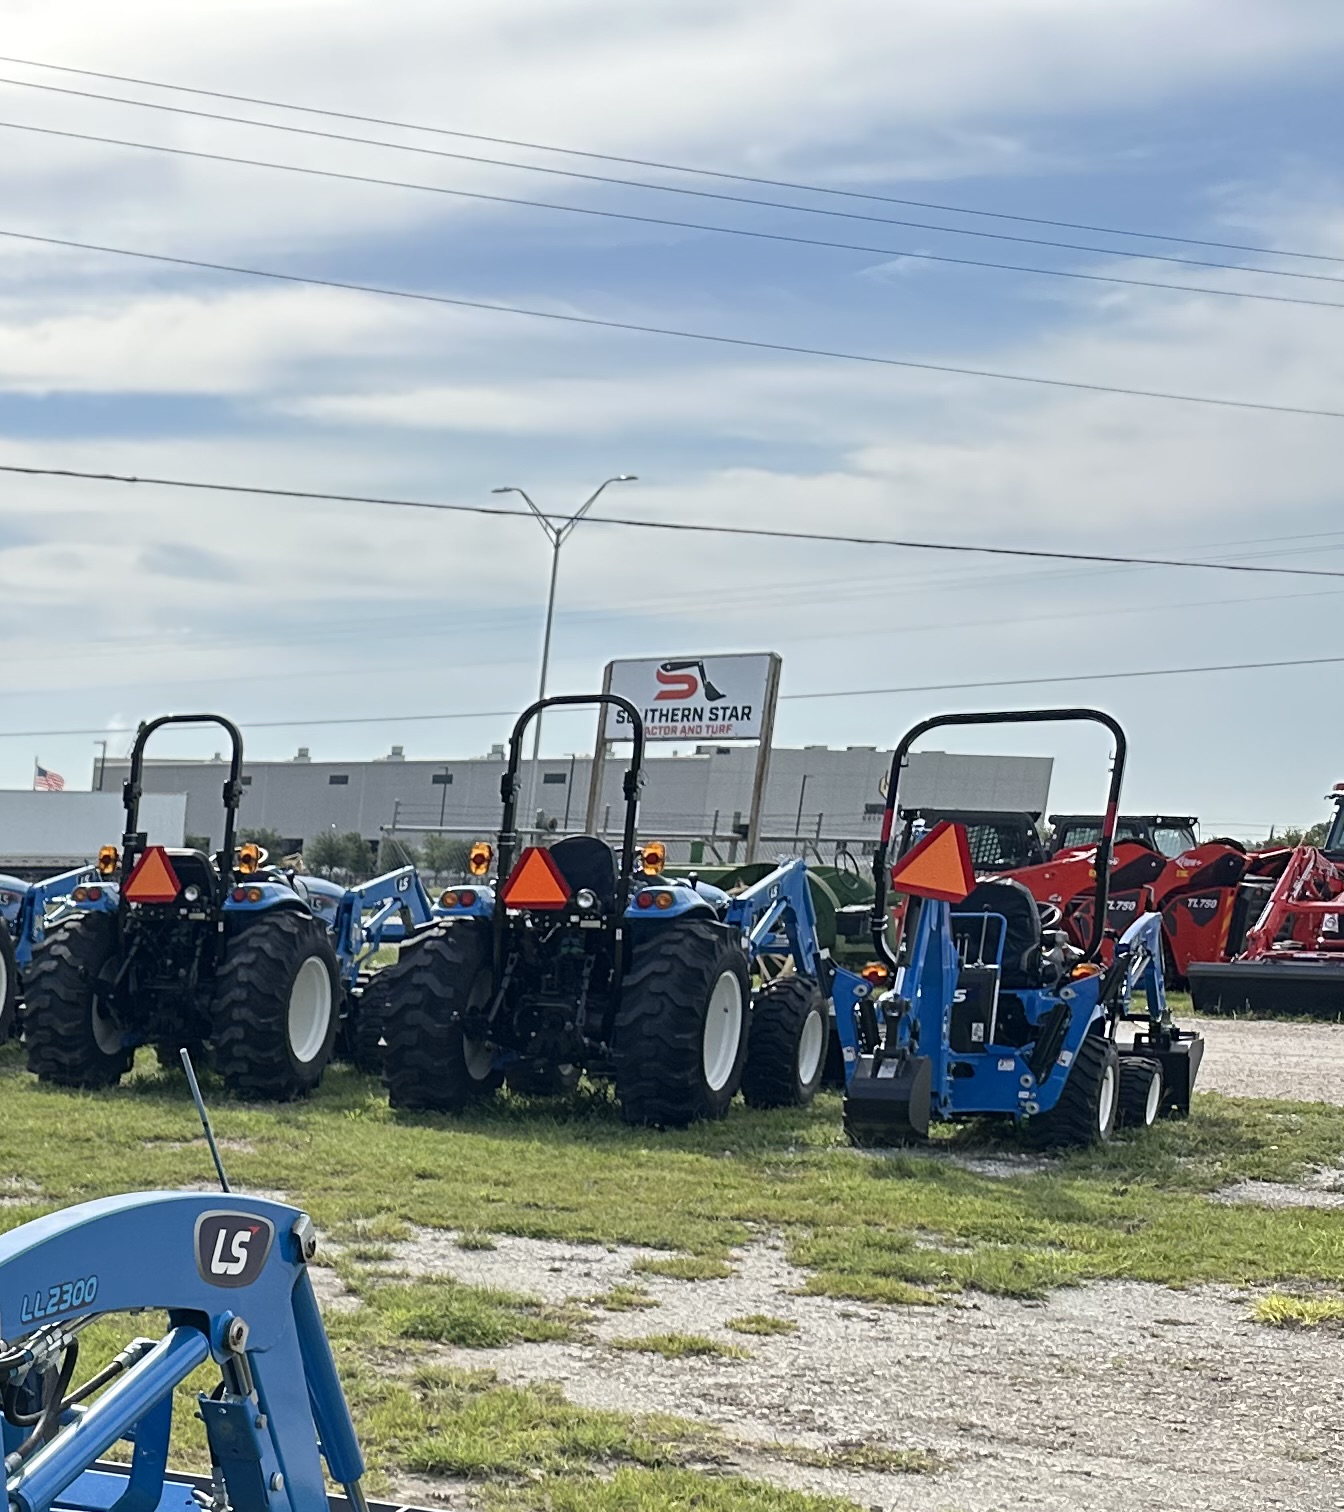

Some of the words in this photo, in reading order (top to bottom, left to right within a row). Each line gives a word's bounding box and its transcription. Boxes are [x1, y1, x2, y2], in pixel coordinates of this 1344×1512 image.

[708, 705, 753, 722] STAR
[679, 724, 703, 736] AND
[705, 723, 733, 735] TURF
[1187, 898, 1218, 909] TL750
[210, 1228, 253, 1275] LS
[20, 1275, 99, 1323] LL2300
